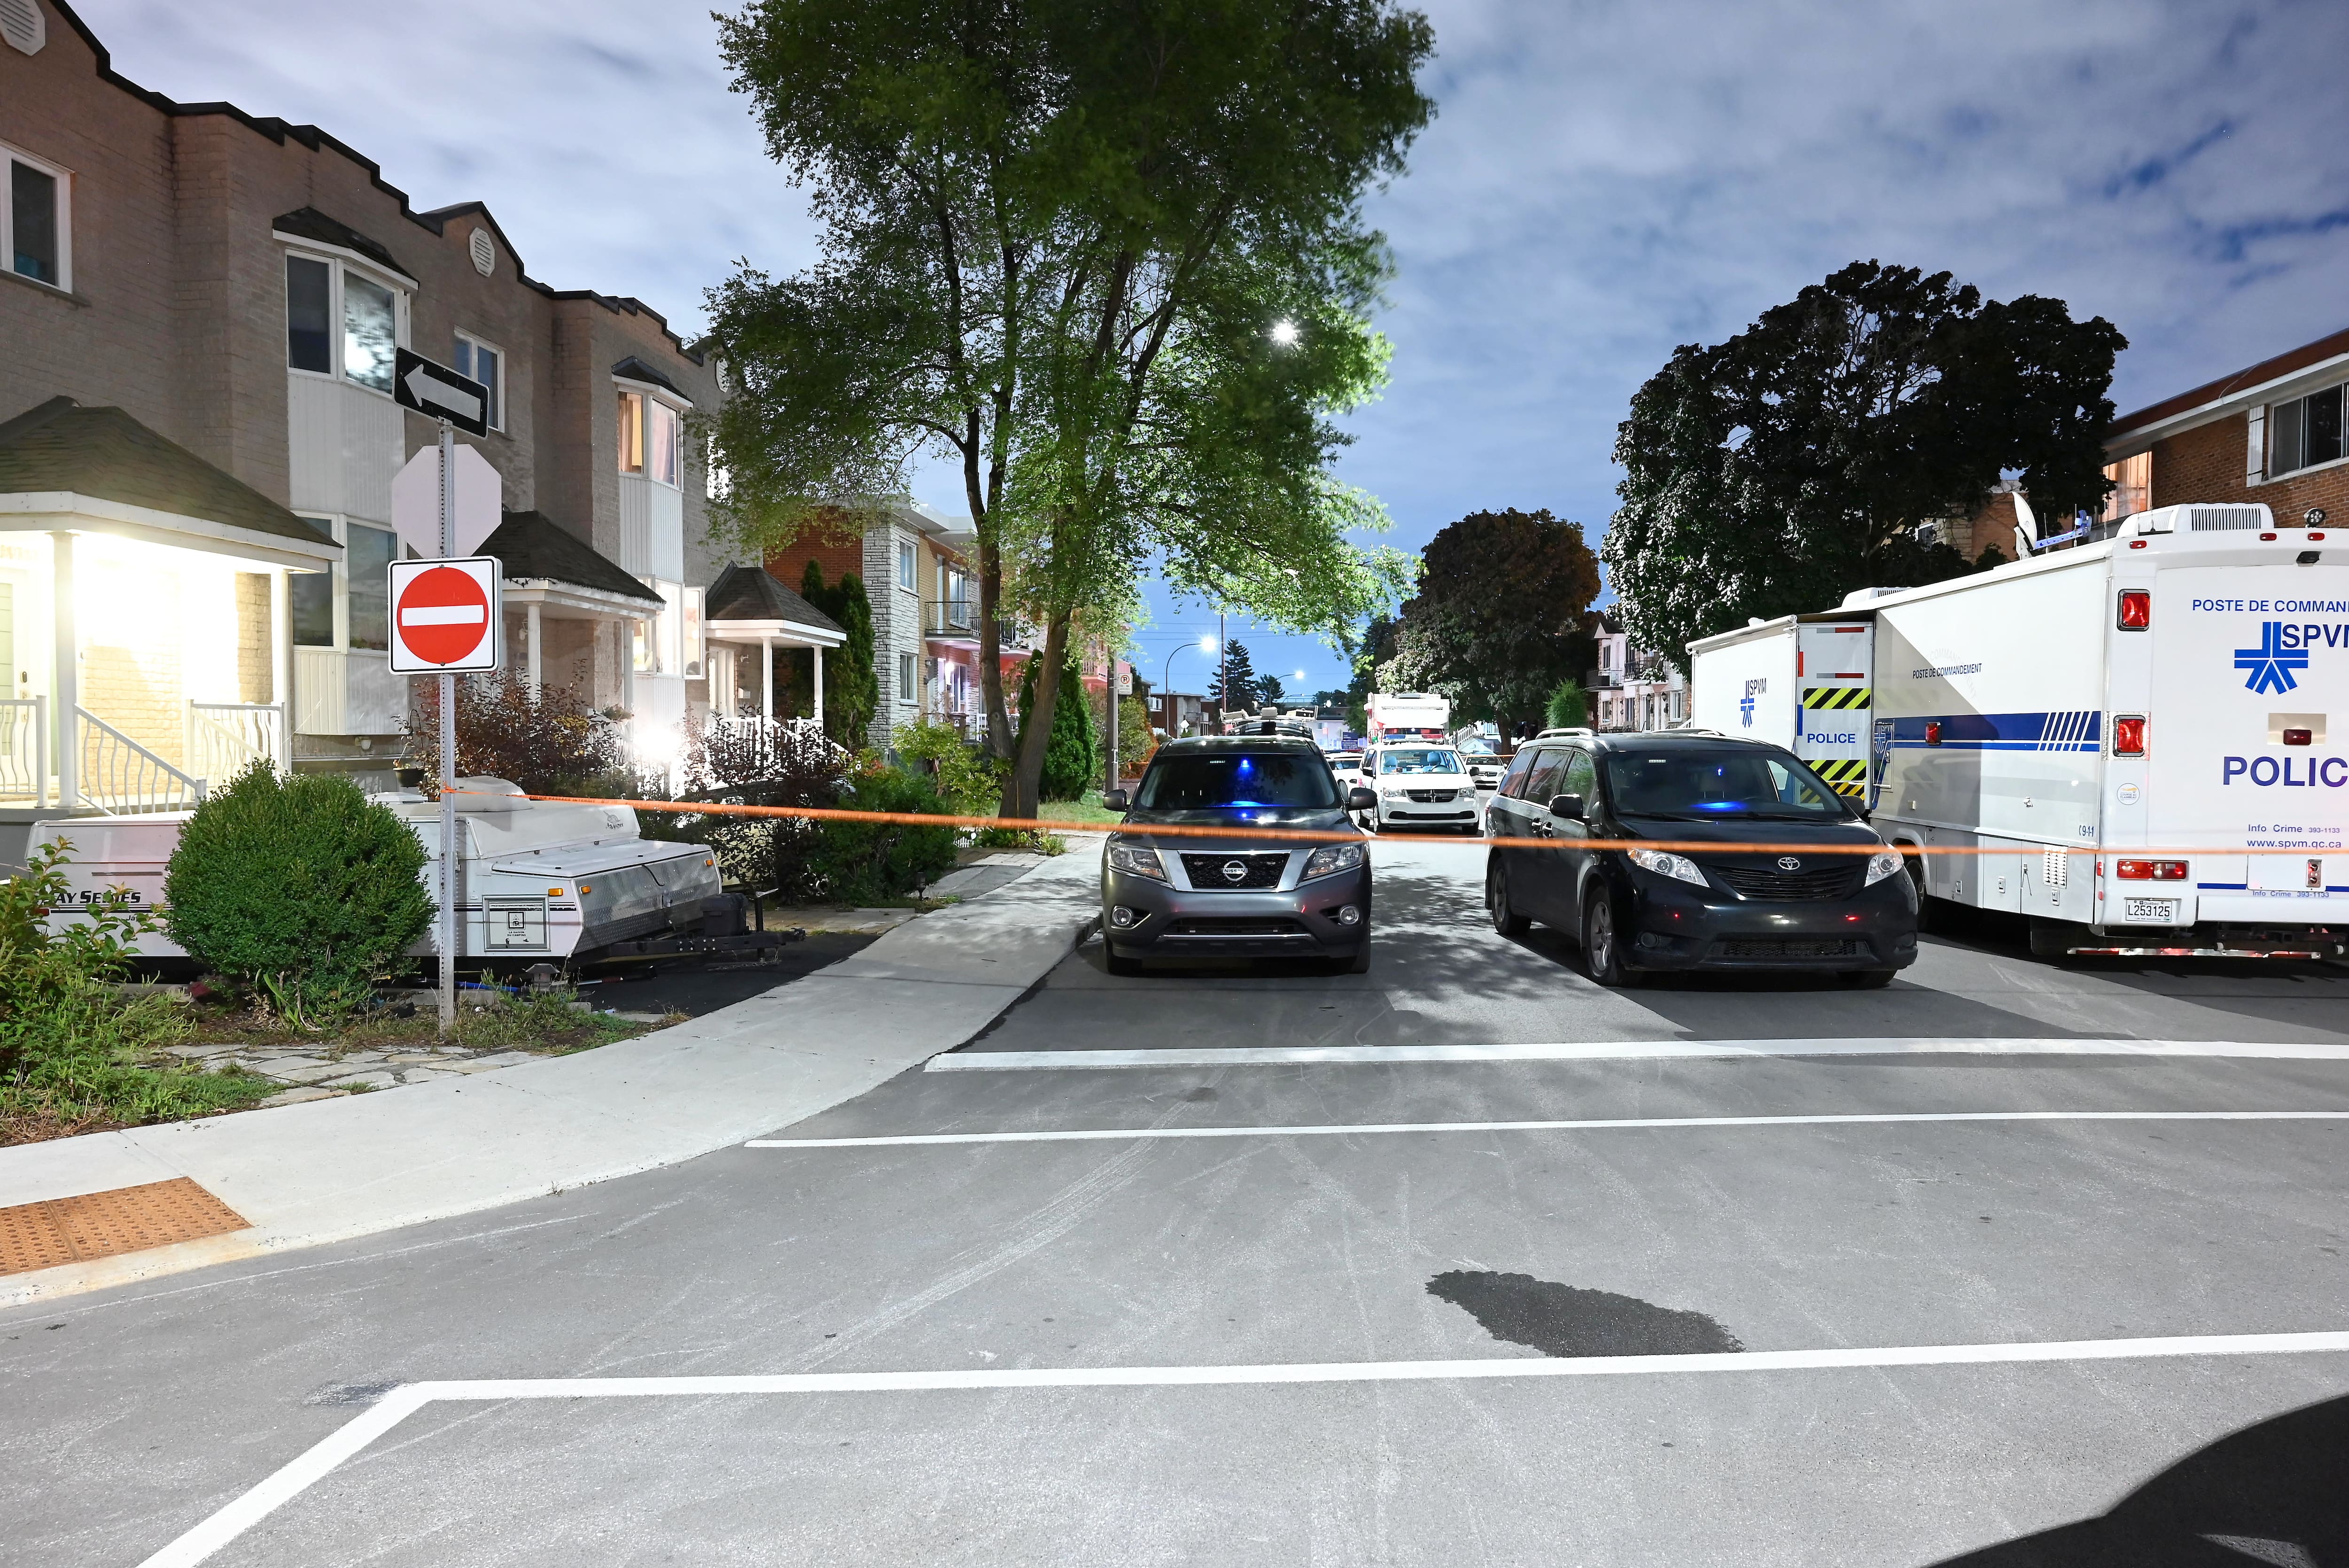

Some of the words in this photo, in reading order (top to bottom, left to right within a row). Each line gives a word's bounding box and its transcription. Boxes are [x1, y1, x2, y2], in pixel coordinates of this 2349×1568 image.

[2192, 599, 2244, 611] POSTE
[2249, 600, 2269, 611] DE
[2274, 600, 2349, 612] COMMAN
[1913, 668, 1928, 679] POSTE
[1929, 668, 1936, 677] DE
[1937, 663, 1982, 677] COMMANDEMENT
[1750, 678, 1766, 696] SPVM
[1807, 733, 1856, 743] POLICE
[2082, 825, 2094, 837] 9-1-1
[2273, 824, 2302, 832] Crime
[2247, 840, 2341, 849] www.spvm.qc.ca
[53, 893, 77, 903] AY
[2128, 904, 2170, 917] L253125
